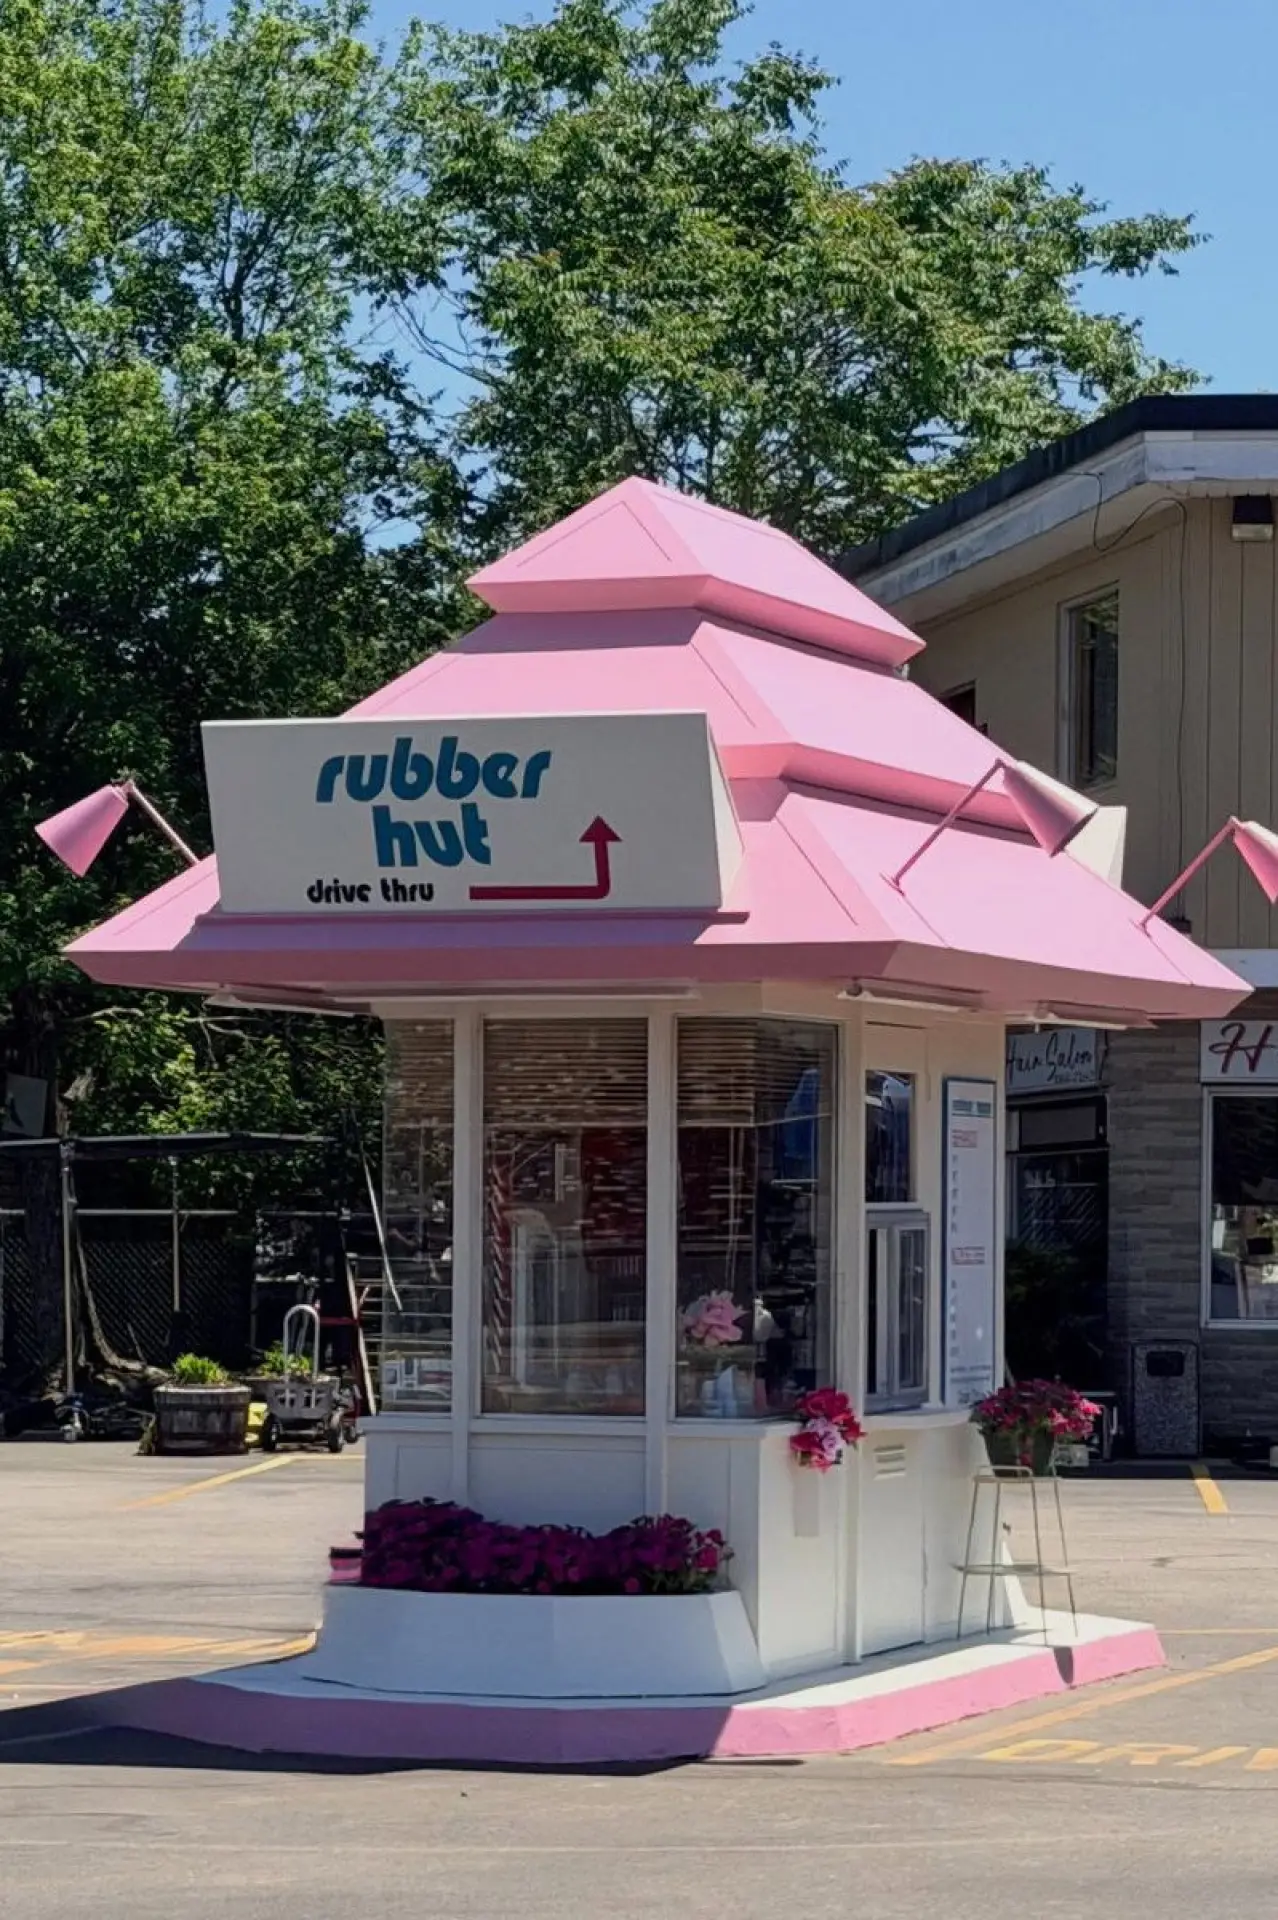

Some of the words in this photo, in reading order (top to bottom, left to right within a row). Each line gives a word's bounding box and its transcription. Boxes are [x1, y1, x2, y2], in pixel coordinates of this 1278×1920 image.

[315, 736, 552, 803] rubber
[371, 803, 492, 868] hut
[306, 879, 372, 904] drive
[380, 877, 435, 903] thru
[1045, 1031, 1092, 1082] Salon
